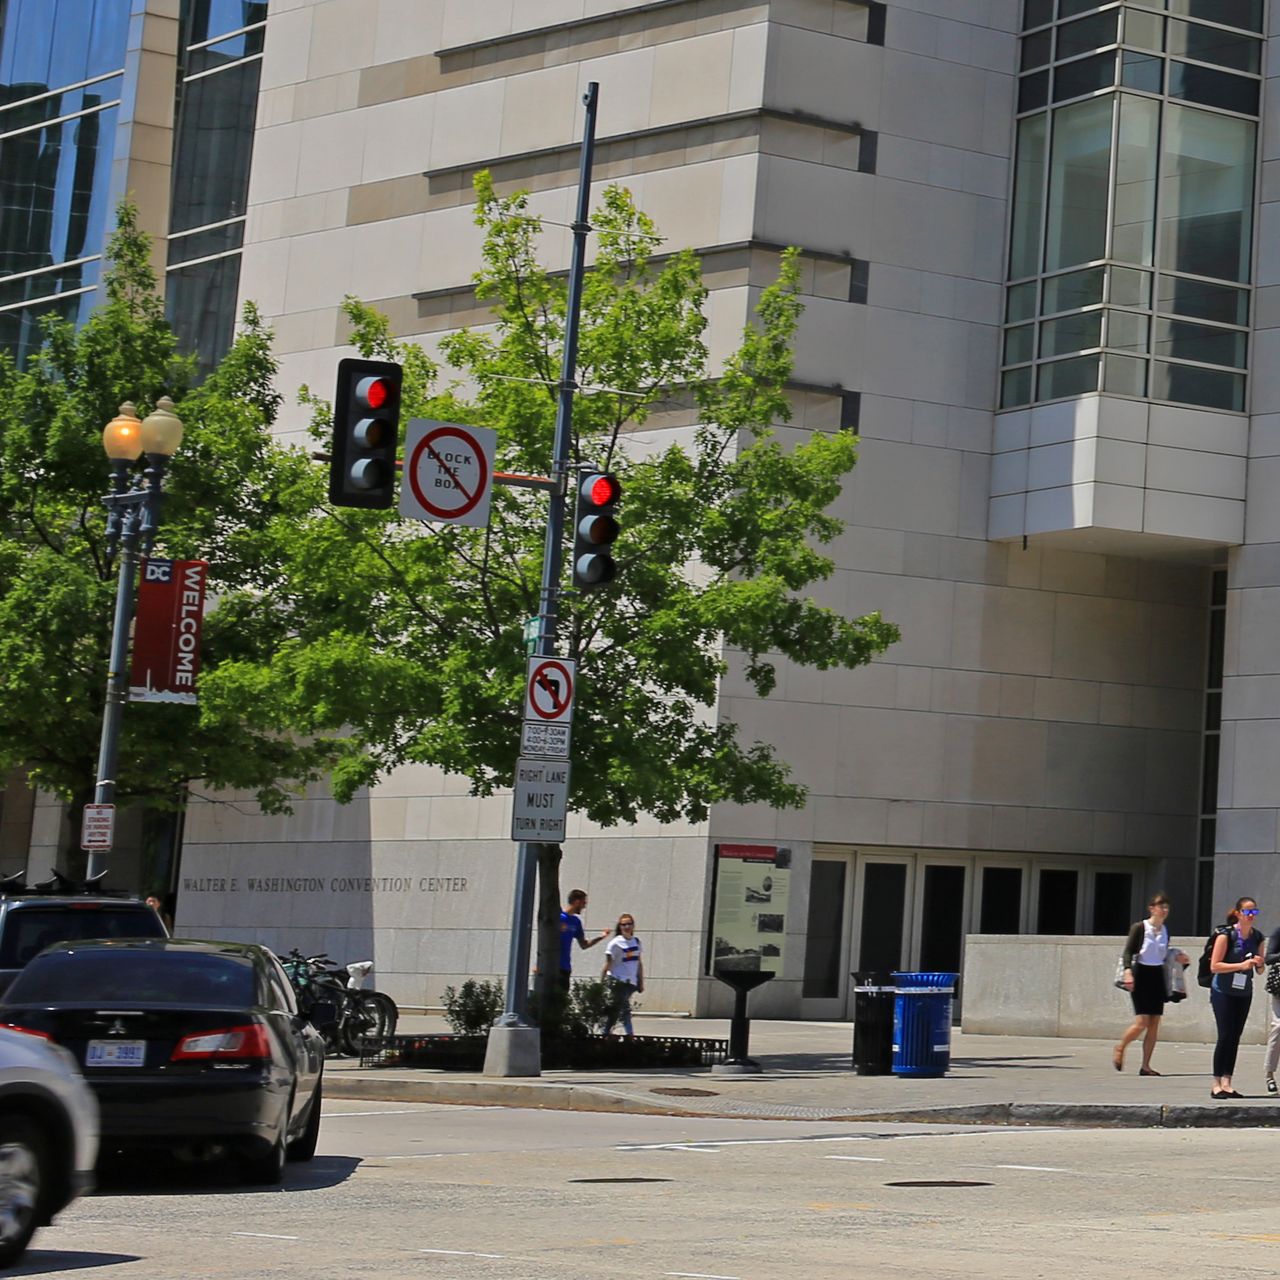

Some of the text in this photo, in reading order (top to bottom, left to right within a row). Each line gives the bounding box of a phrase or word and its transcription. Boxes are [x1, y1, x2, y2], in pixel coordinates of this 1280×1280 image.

[145, 565, 171, 581] DC
[175, 566, 202, 686] WELCOME
[519, 769, 567, 784] RIGHT LANE
[526, 792, 555, 808] MUST
[515, 817, 564, 831] TURN RIGHT
[183, 878, 226, 892] WALTER
[247, 878, 325, 892] WASHINGTON
[330, 878, 412, 892] CONVENTION
[419, 877, 468, 892] CENTER
